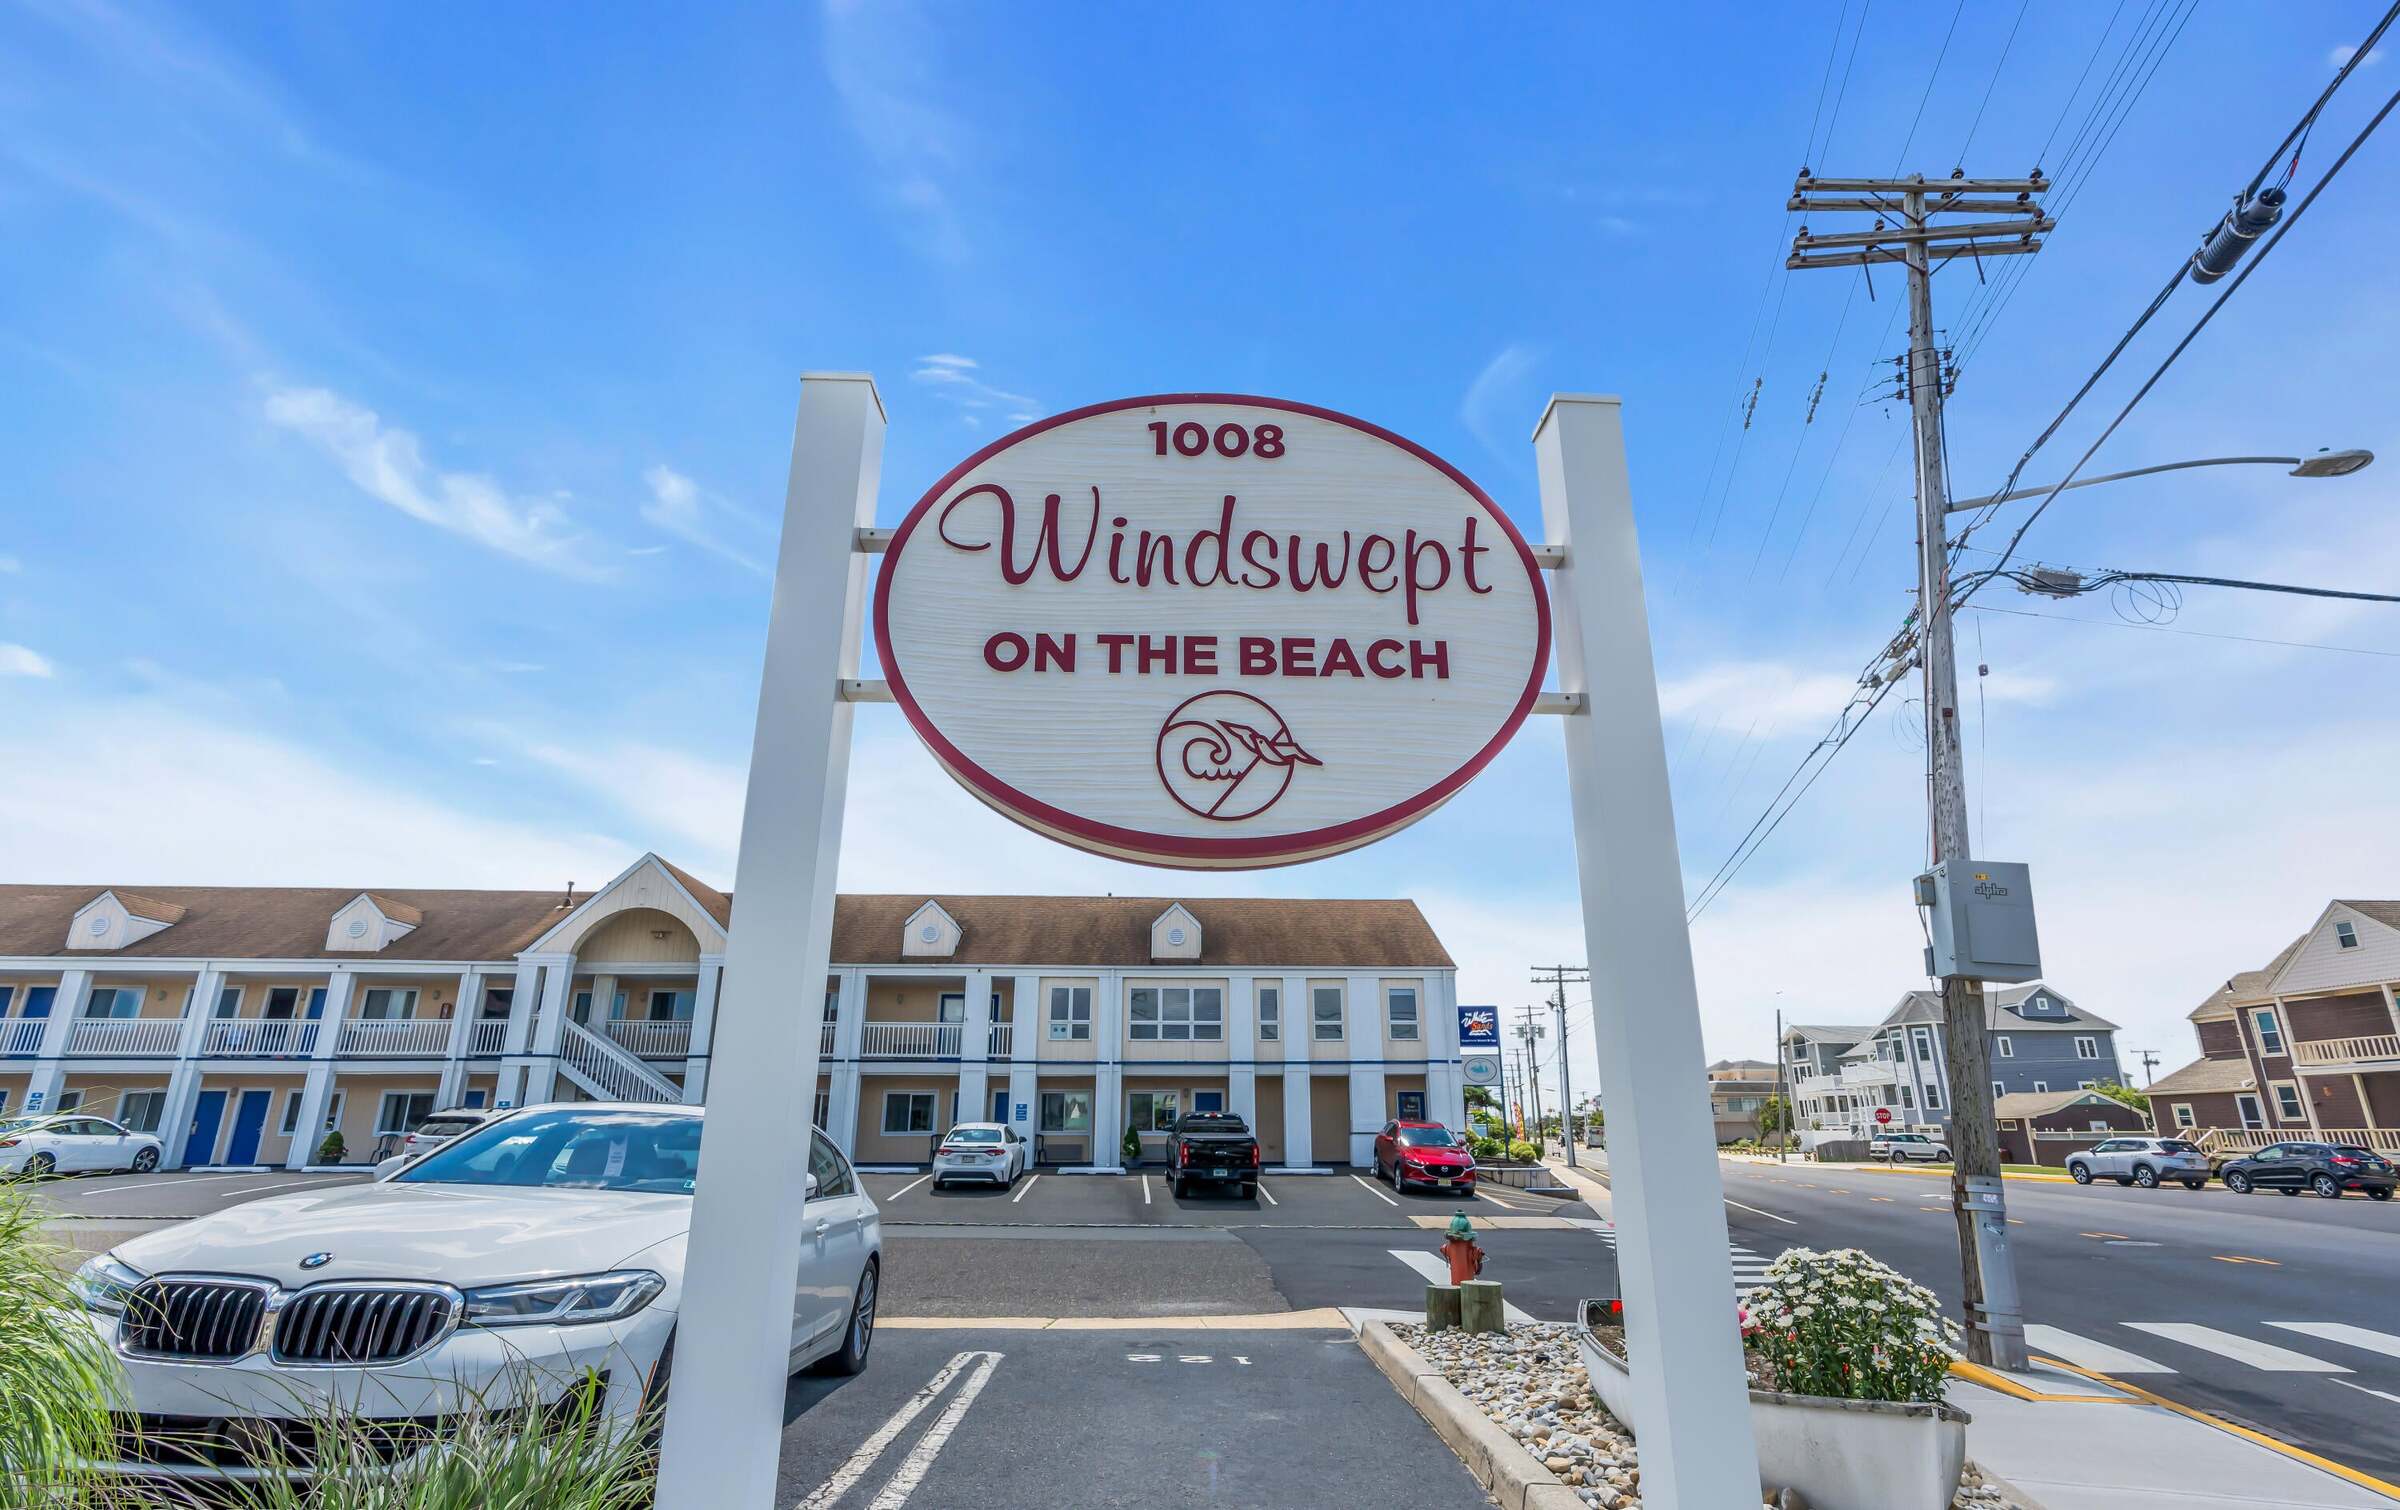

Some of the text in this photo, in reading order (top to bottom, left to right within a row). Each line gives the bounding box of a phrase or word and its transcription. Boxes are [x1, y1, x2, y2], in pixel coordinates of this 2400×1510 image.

[1148, 421, 1285, 459] 1008
[938, 483, 1493, 625] Windswept
[983, 632, 1450, 679] ON THE BEACH
[1975, 882, 2008, 900] alpha
